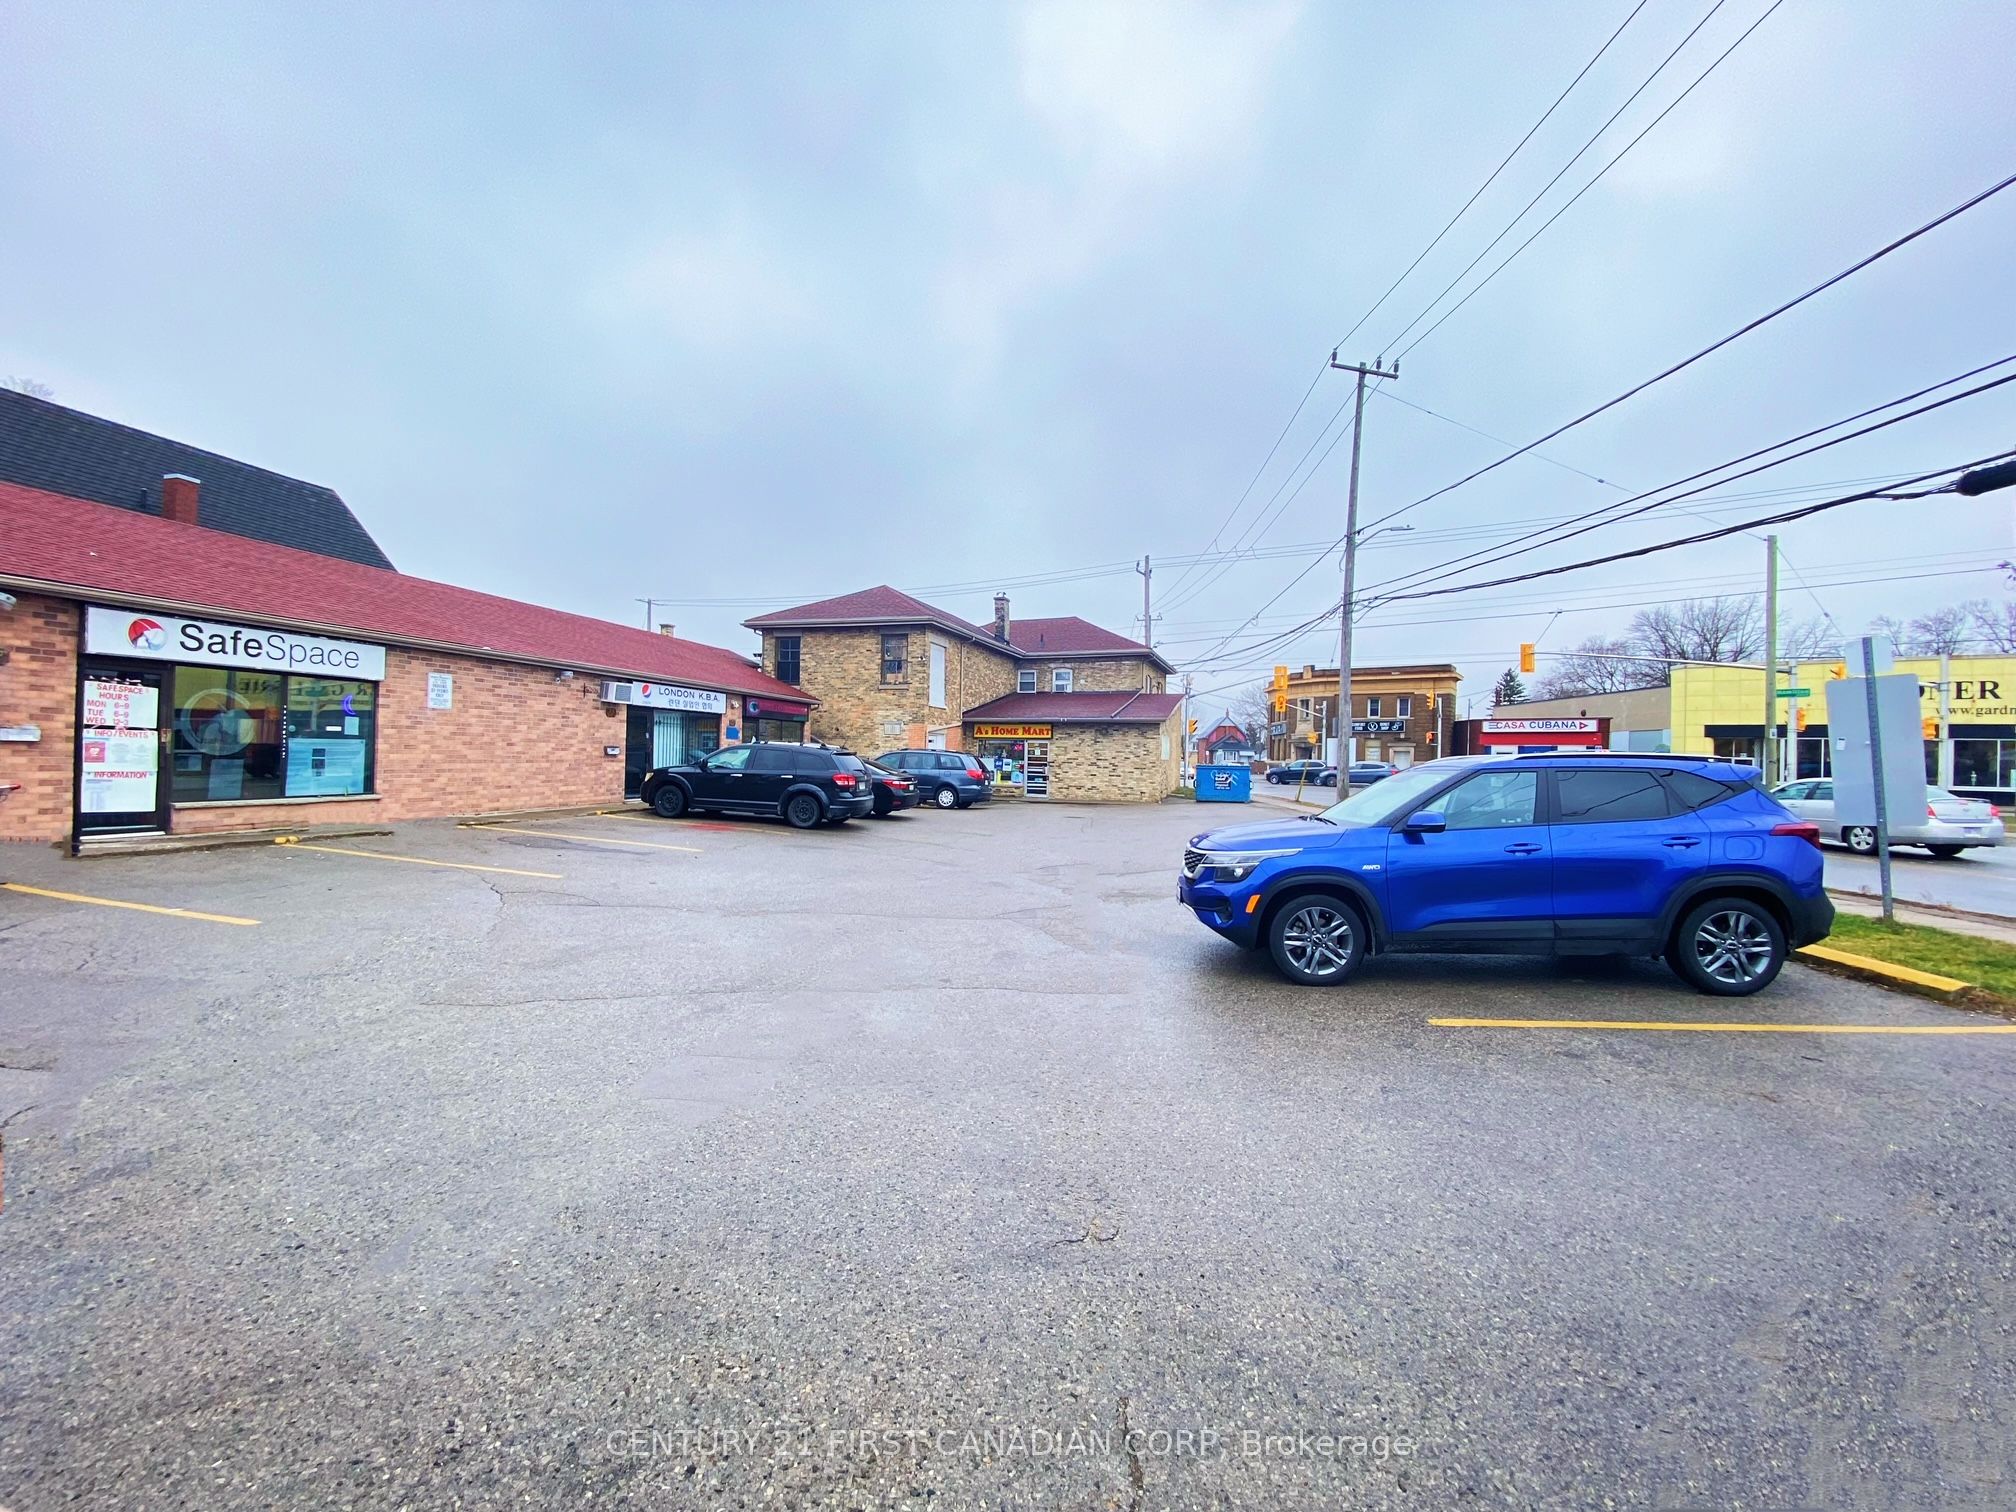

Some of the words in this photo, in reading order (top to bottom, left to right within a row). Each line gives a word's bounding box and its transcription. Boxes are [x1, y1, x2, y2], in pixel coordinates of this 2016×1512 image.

[179, 623, 360, 669] SafeSpace
[98, 692, 130, 701] HOURS
[658, 687, 695, 699] LONDON
[698, 692, 720, 702] K.B.A.
[86, 699, 107, 708] MON
[87, 708, 105, 716] TUE
[85, 716, 107, 724] WED
[1496, 721, 1526, 729] CASA
[1529, 721, 1577, 729] CUBANA
[990, 726, 1020, 736] HOME
[1022, 726, 1051, 736] MART
[93, 771, 148, 779] INFORMATION
